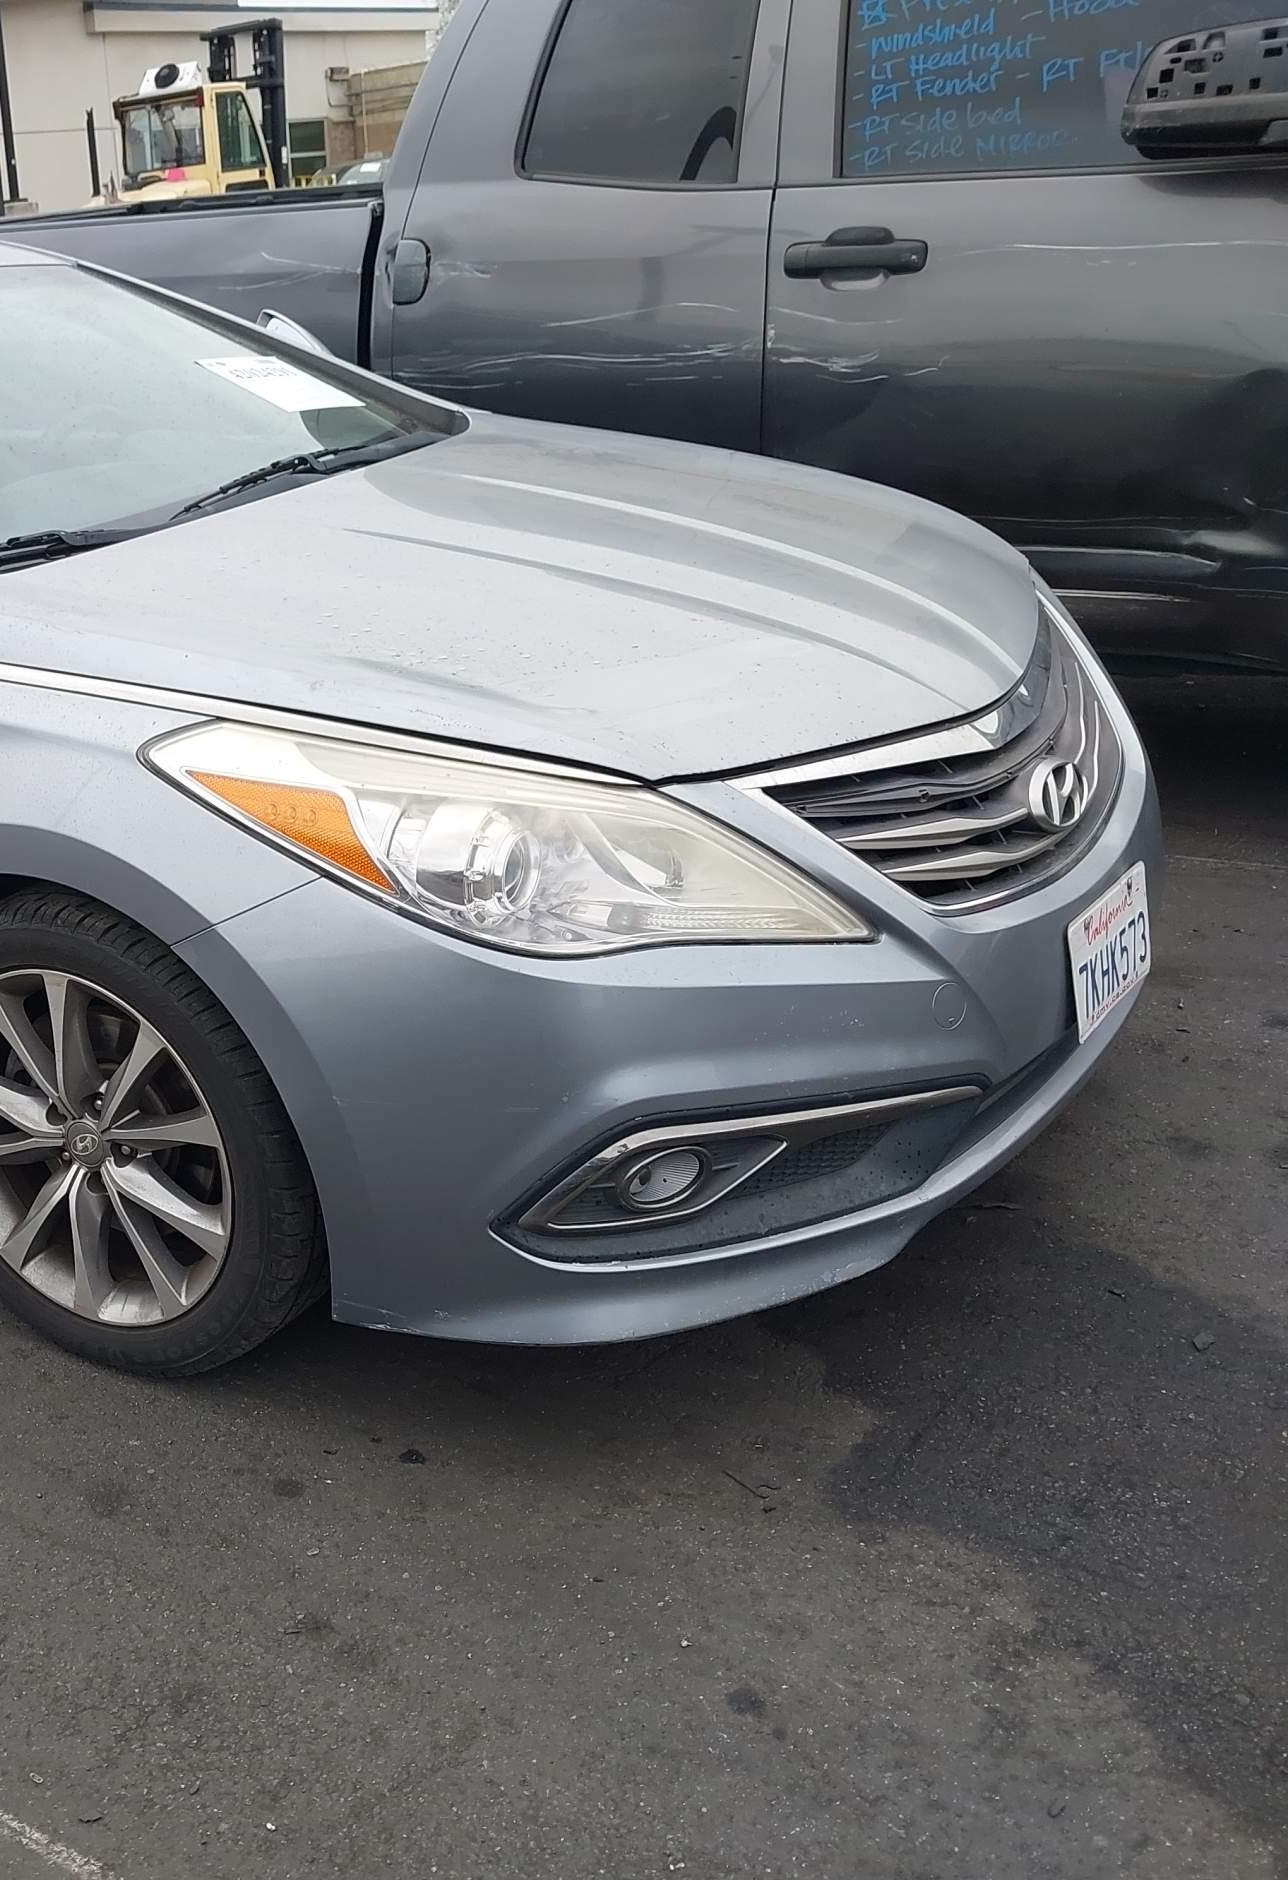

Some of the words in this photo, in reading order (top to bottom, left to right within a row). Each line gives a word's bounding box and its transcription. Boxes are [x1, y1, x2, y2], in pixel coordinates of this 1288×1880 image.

[871, 58, 905, 80] LT
[871, 81, 910, 109] RT
[1042, 57, 1084, 93] RT
[863, 113, 900, 141] RT
[967, 96, 1022, 127] bed
[864, 143, 897, 169] RT
[1082, 895, 1134, 946] California
[1078, 910, 1148, 1020] 7KHK573
